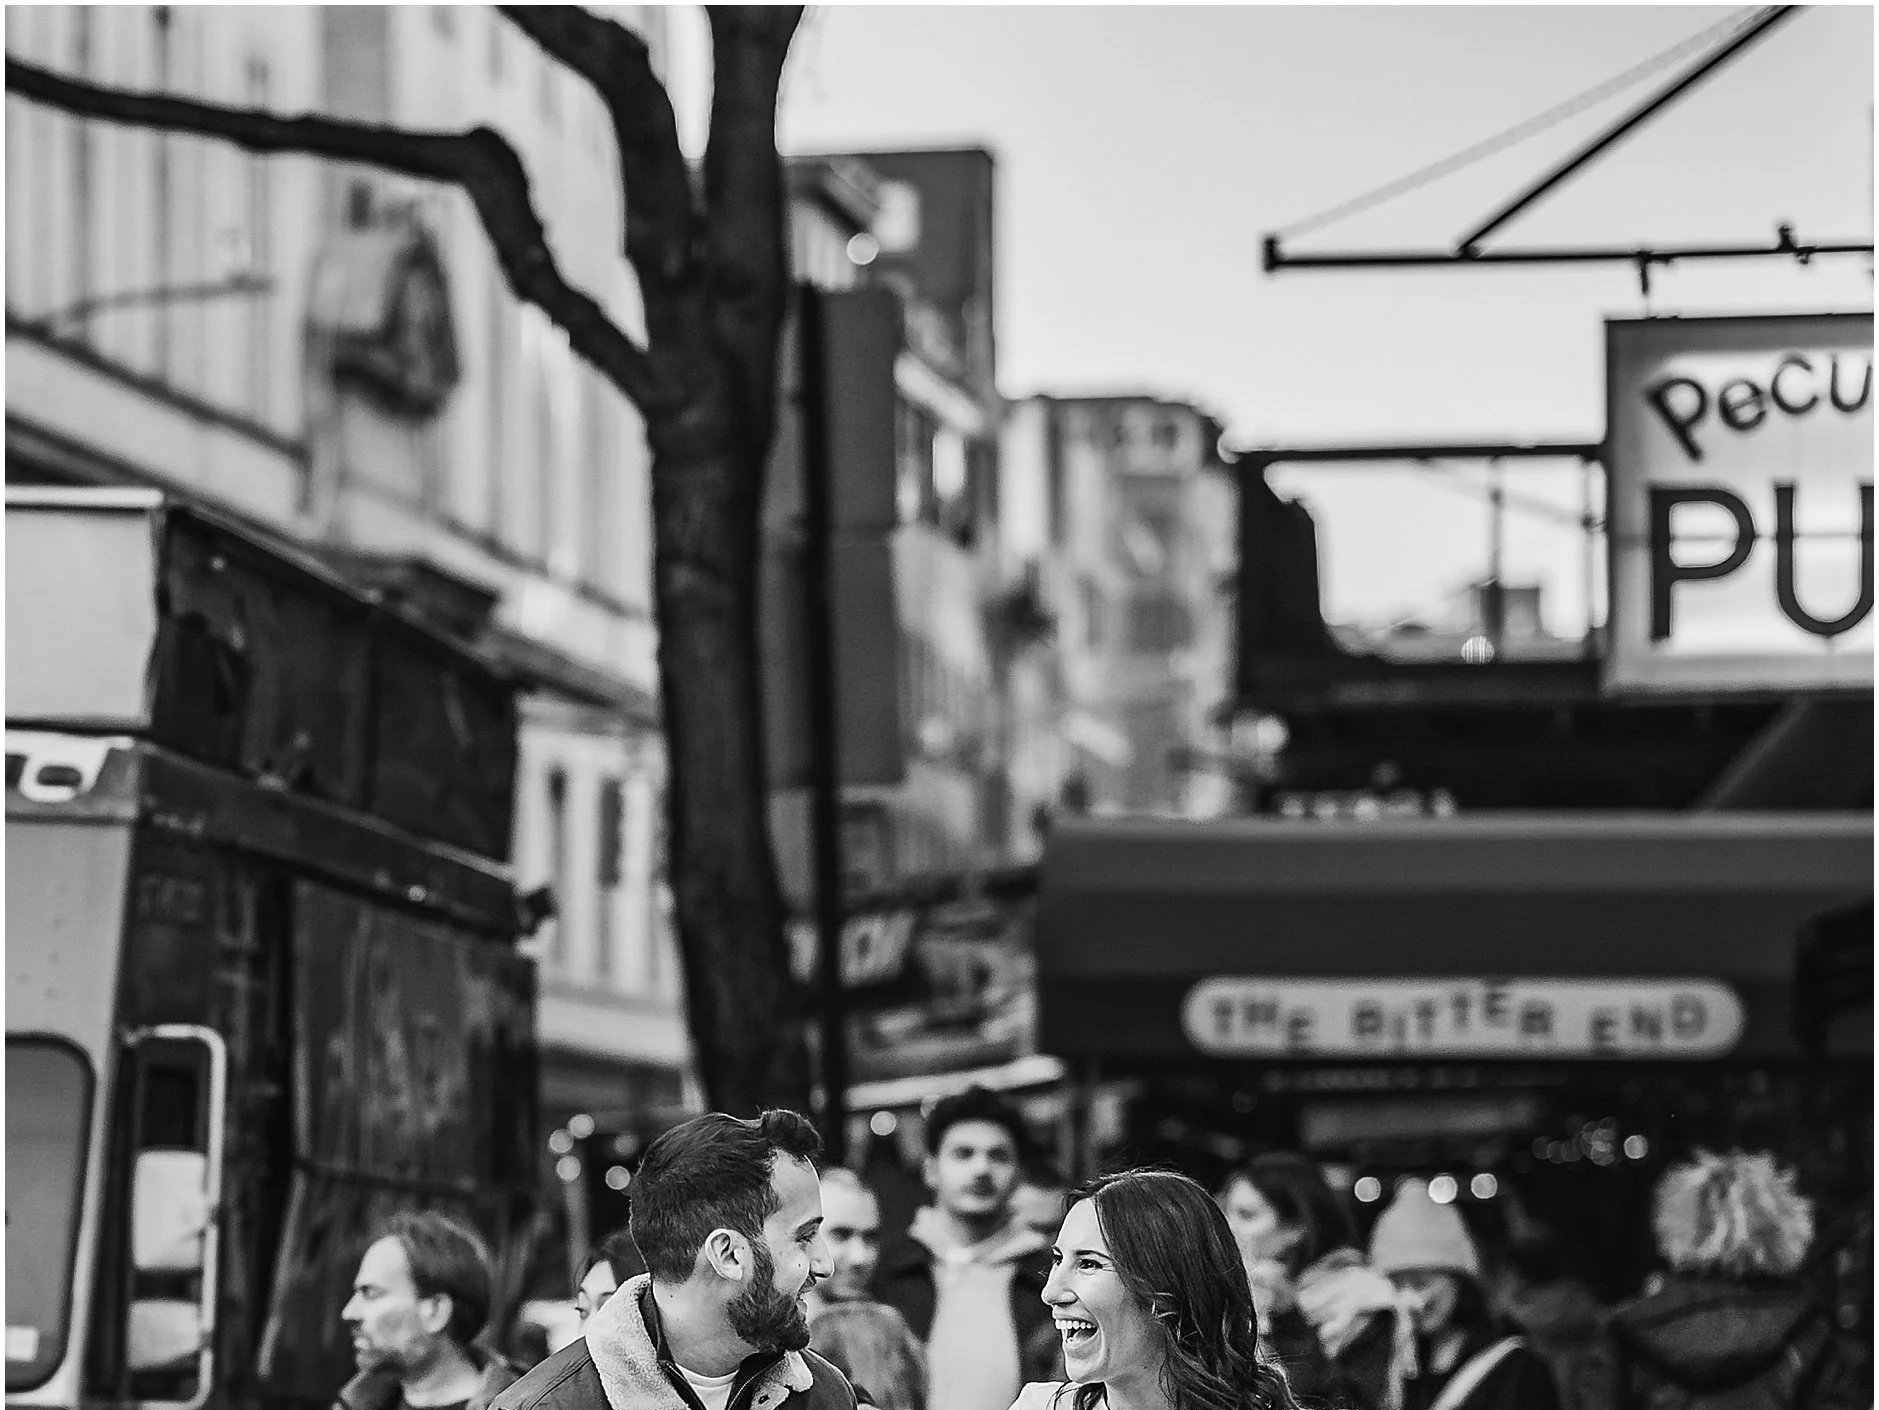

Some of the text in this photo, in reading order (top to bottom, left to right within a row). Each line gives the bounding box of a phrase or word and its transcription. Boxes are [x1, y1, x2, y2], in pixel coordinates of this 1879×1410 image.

[1651, 486, 1874, 636] PU
[1212, 996, 1314, 1047] THE
[1592, 993, 1709, 1047] END
